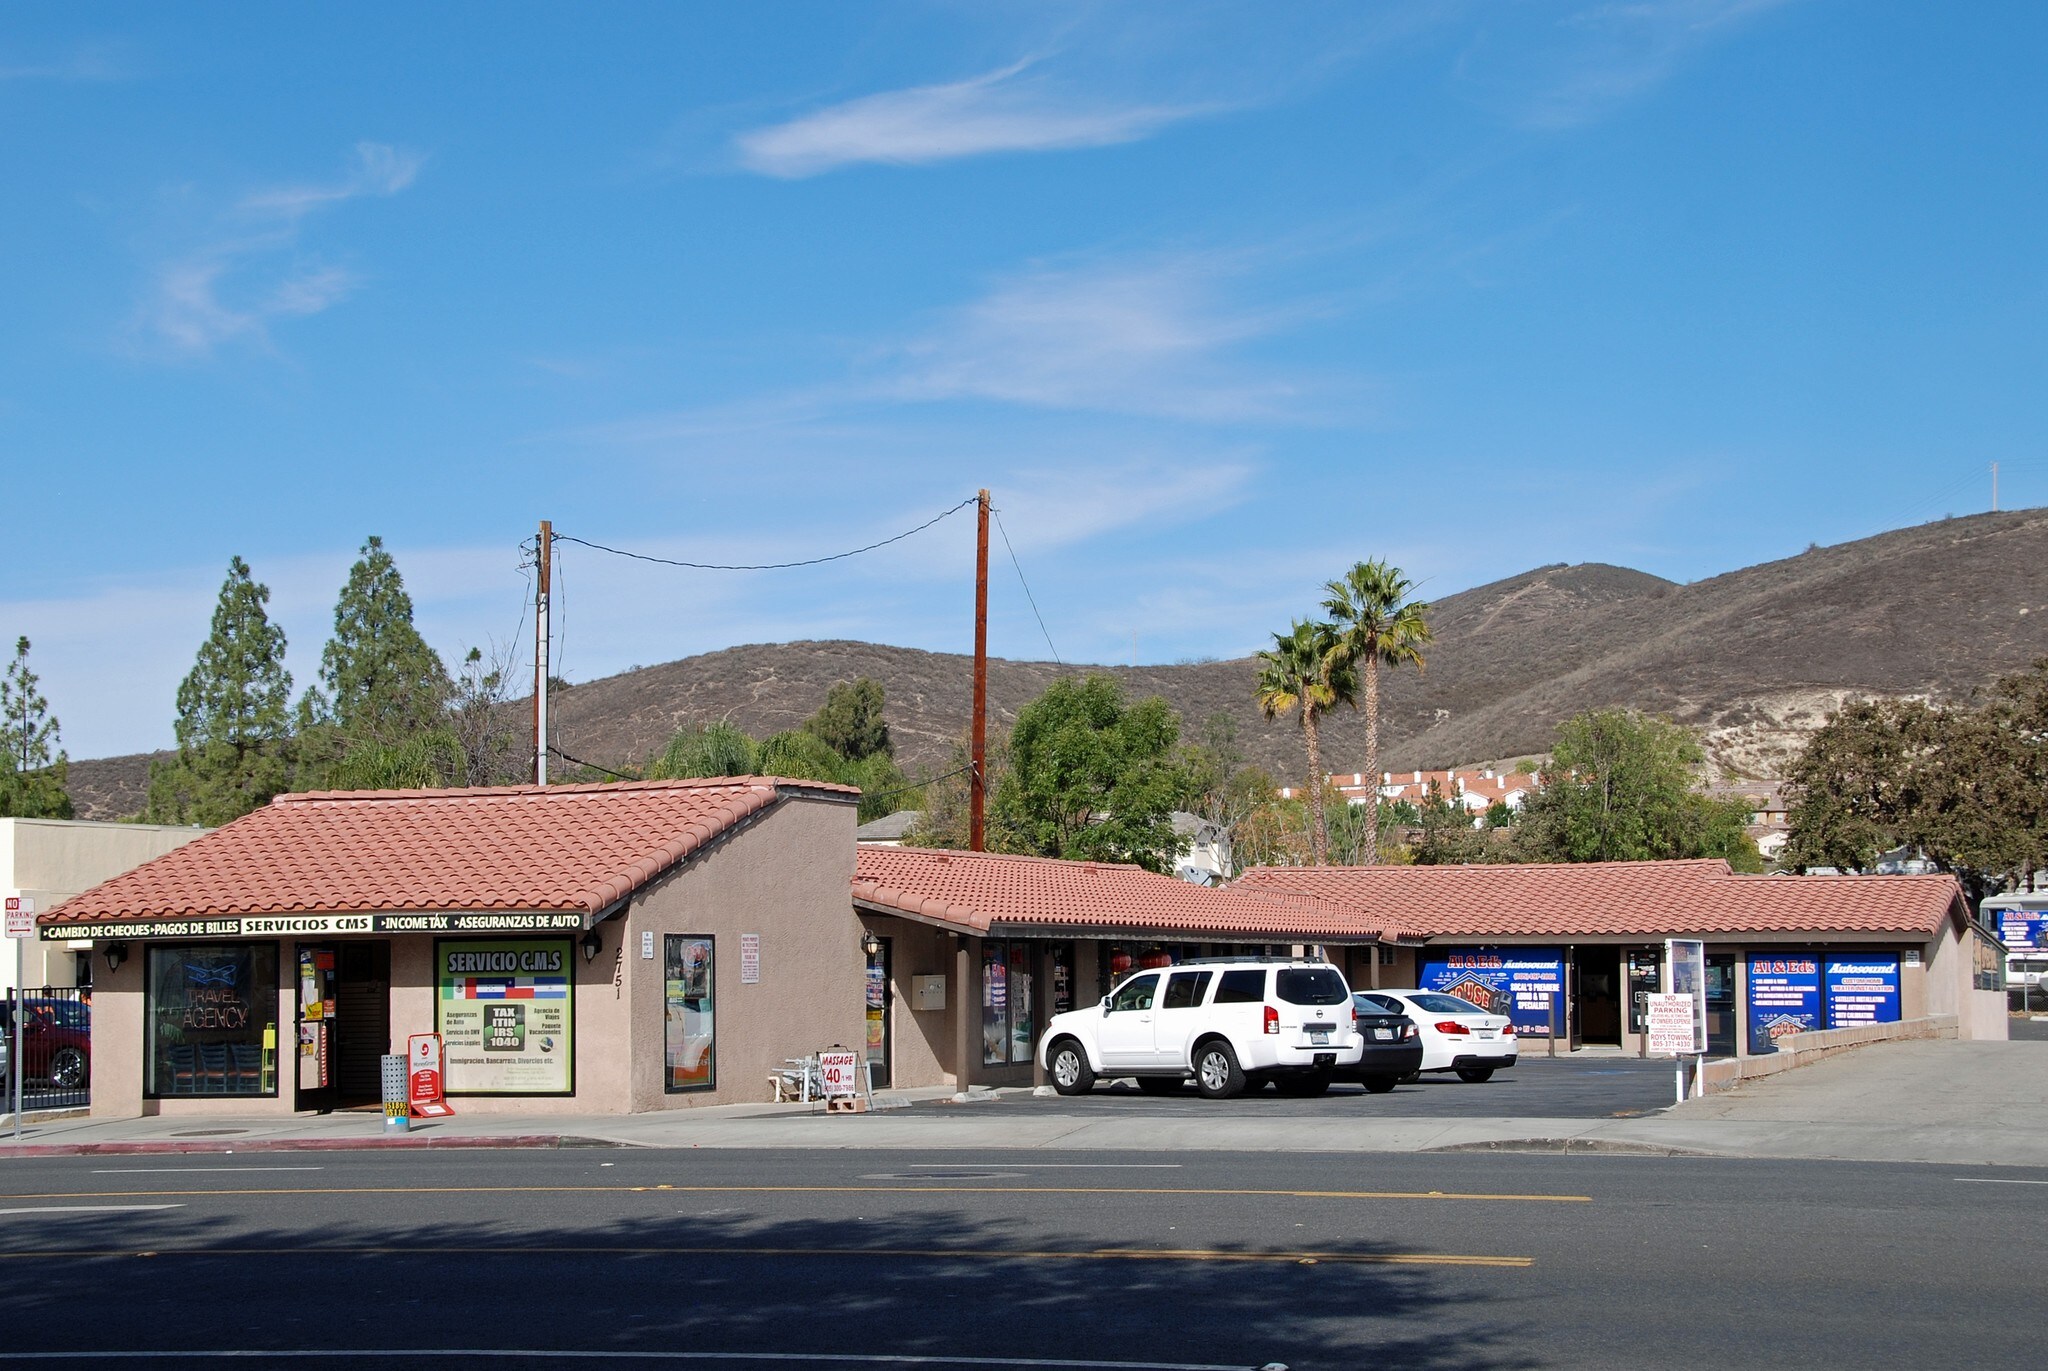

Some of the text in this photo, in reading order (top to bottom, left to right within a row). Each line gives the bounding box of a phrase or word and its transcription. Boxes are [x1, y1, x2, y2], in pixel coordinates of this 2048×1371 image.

[6, 899, 18, 909] NO
[246, 918, 368, 932] SERVICIOS CMS
[385, 917, 428, 929] INCOME
[458, 916, 534, 929] ASEGURANZAS
[535, 915, 549, 927] DE
[551, 914, 580, 927] AUTO
[48, 921, 239, 938] CAMBIO DE CHEQUES PAGOS DE BILLES
[448, 951, 562, 972] SERVICIO C.M.S
[1447, 956, 1558, 969] Al & Ed's Autosound
[1753, 960, 1816, 974] Al & Ed's
[615, 947, 623, 1000] 2751
[1828, 963, 1896, 974] Autosound
[187, 989, 240, 1003] TRAVEL
[183, 1007, 247, 1028] AGENCY
[493, 1008, 515, 1017] TAX
[492, 1018, 516, 1027] ITIN
[494, 1028, 514, 1037] IRS
[490, 1037, 519, 1047] 1040
[823, 1056, 854, 1065] MASSAGE
